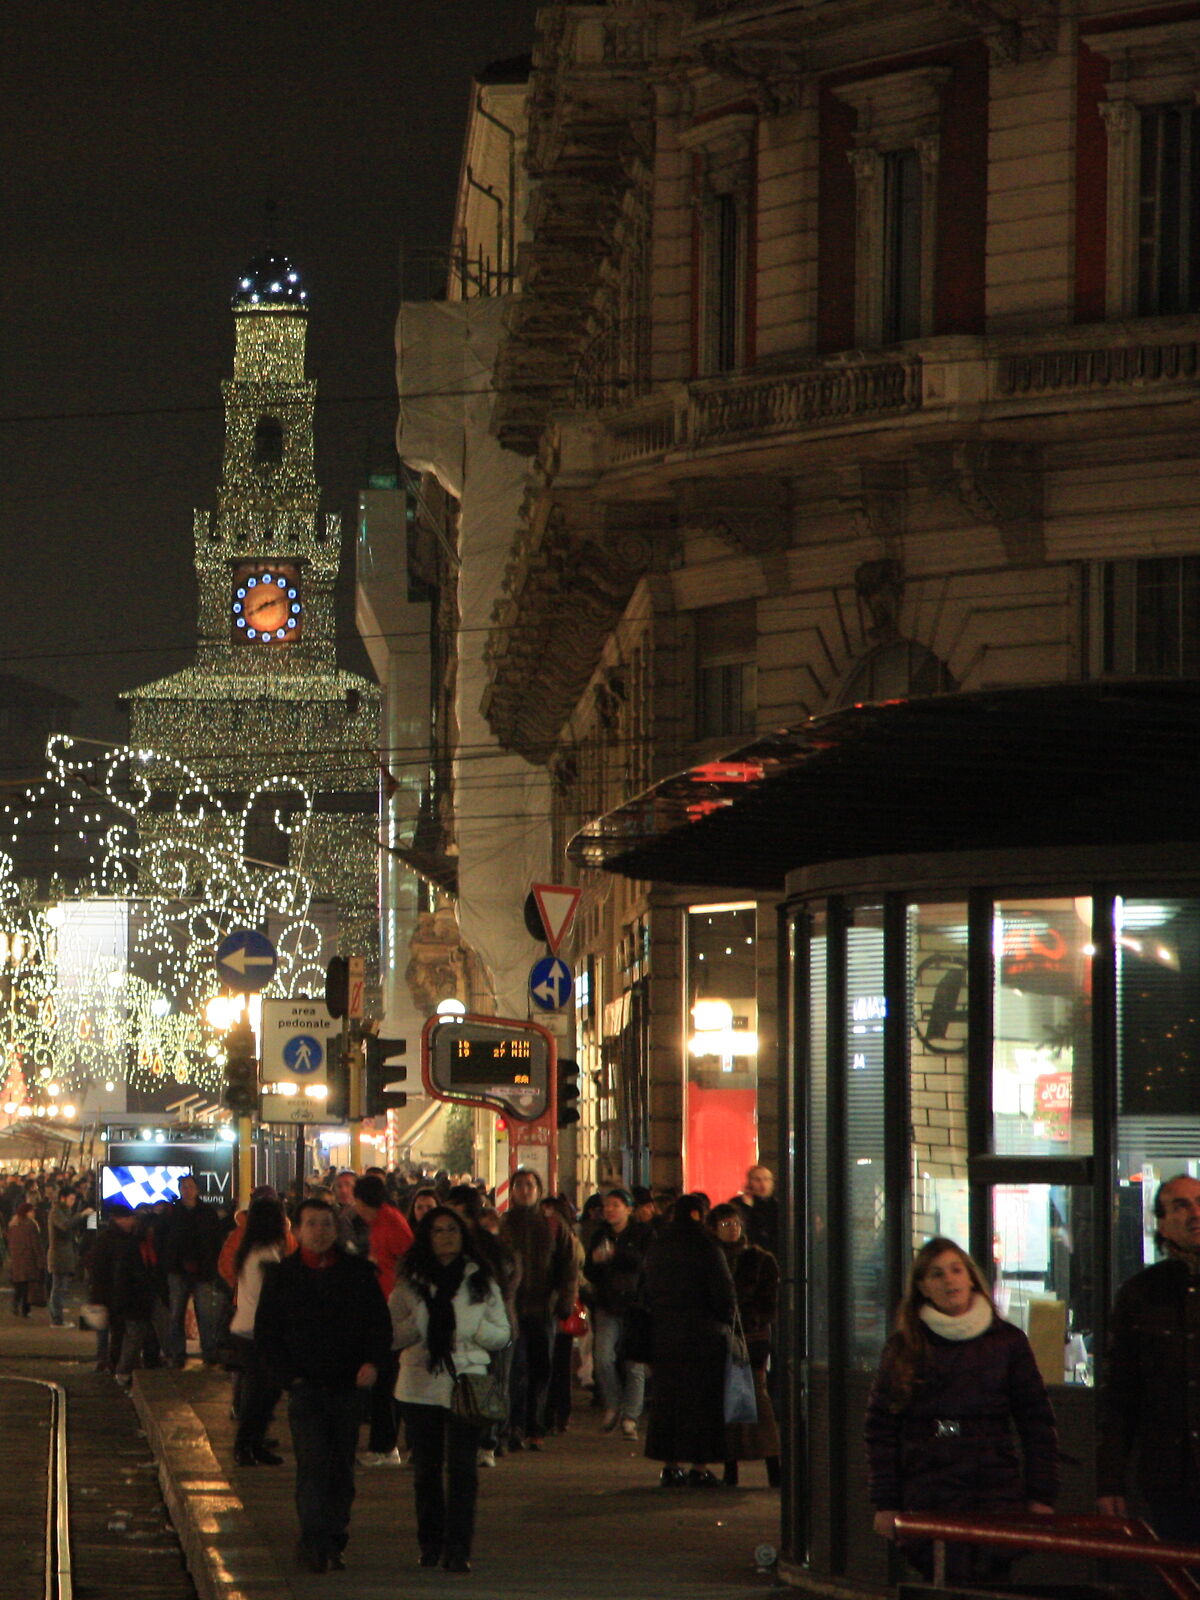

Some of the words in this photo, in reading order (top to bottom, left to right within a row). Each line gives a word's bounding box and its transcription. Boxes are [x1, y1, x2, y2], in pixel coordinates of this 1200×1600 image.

[291, 1007, 316, 1016] area
[278, 1019, 331, 1030] pedonale
[511, 1040, 530, 1049] MIN
[458, 1048, 470, 1058] 19
[493, 1048, 506, 1058] 27
[511, 1048, 530, 1058] MIN
[200, 1171, 230, 1193] TV
